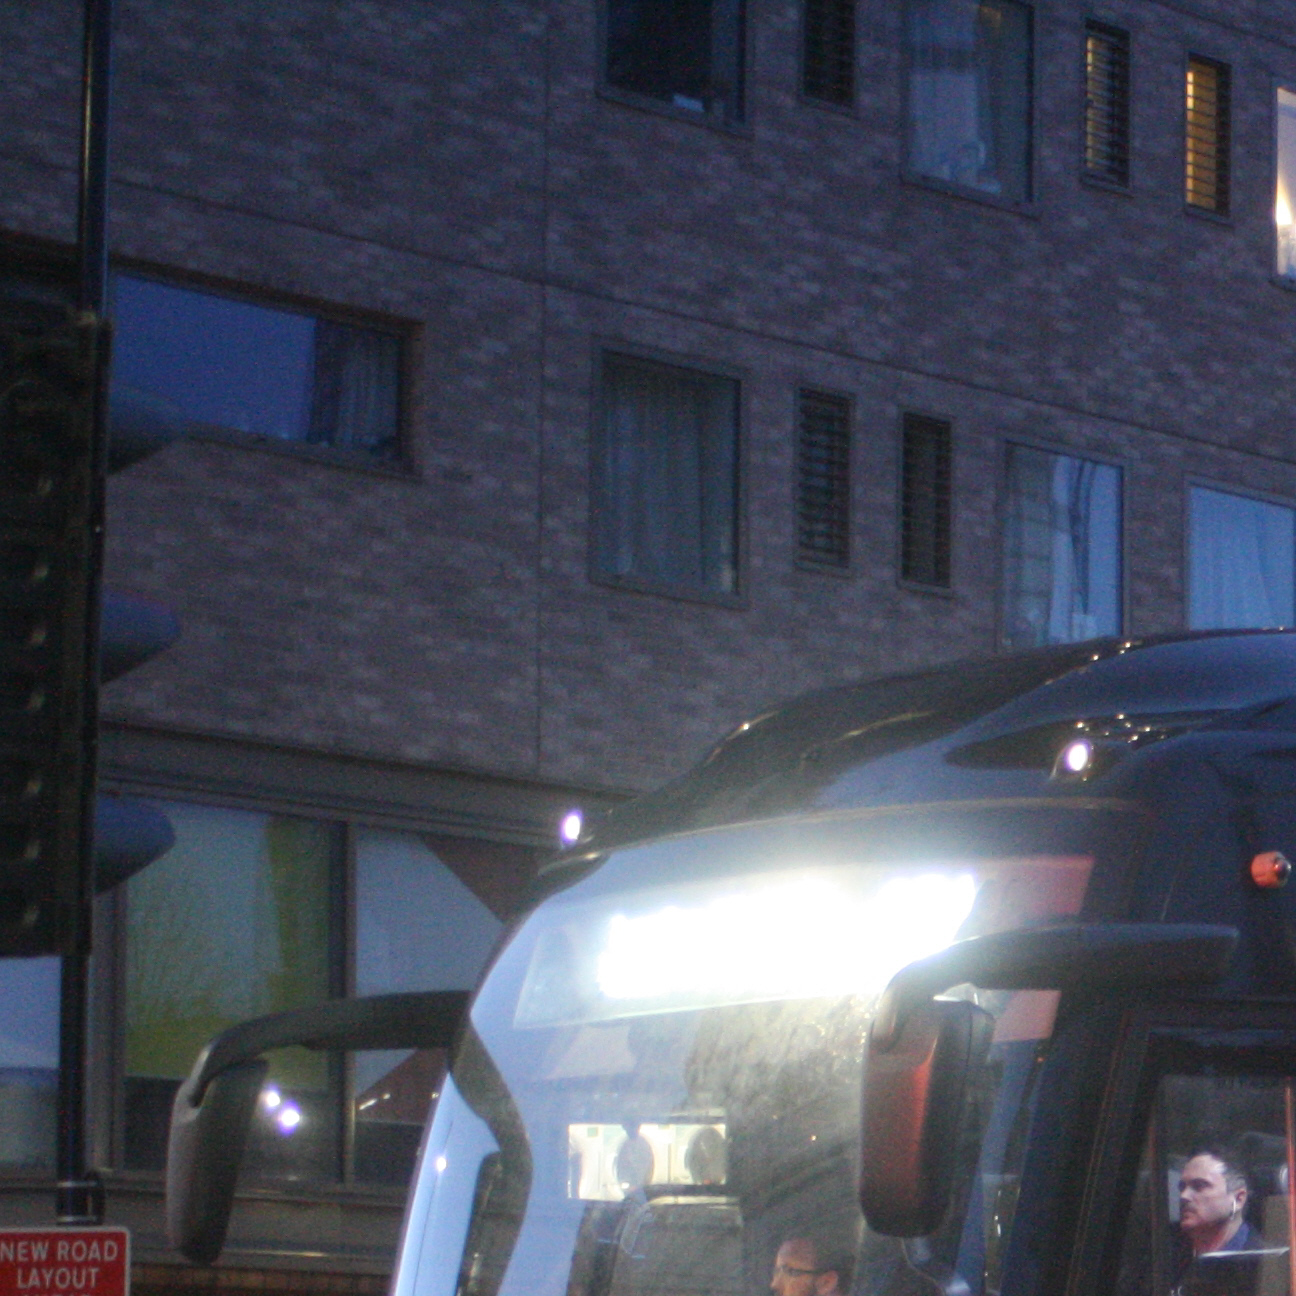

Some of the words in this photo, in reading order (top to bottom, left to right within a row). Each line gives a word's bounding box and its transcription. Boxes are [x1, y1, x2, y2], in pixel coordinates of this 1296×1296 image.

[0, 1241, 49, 1261] NEW
[57, 1240, 118, 1261] ROAD
[17, 1267, 99, 1289] LAYOUT
